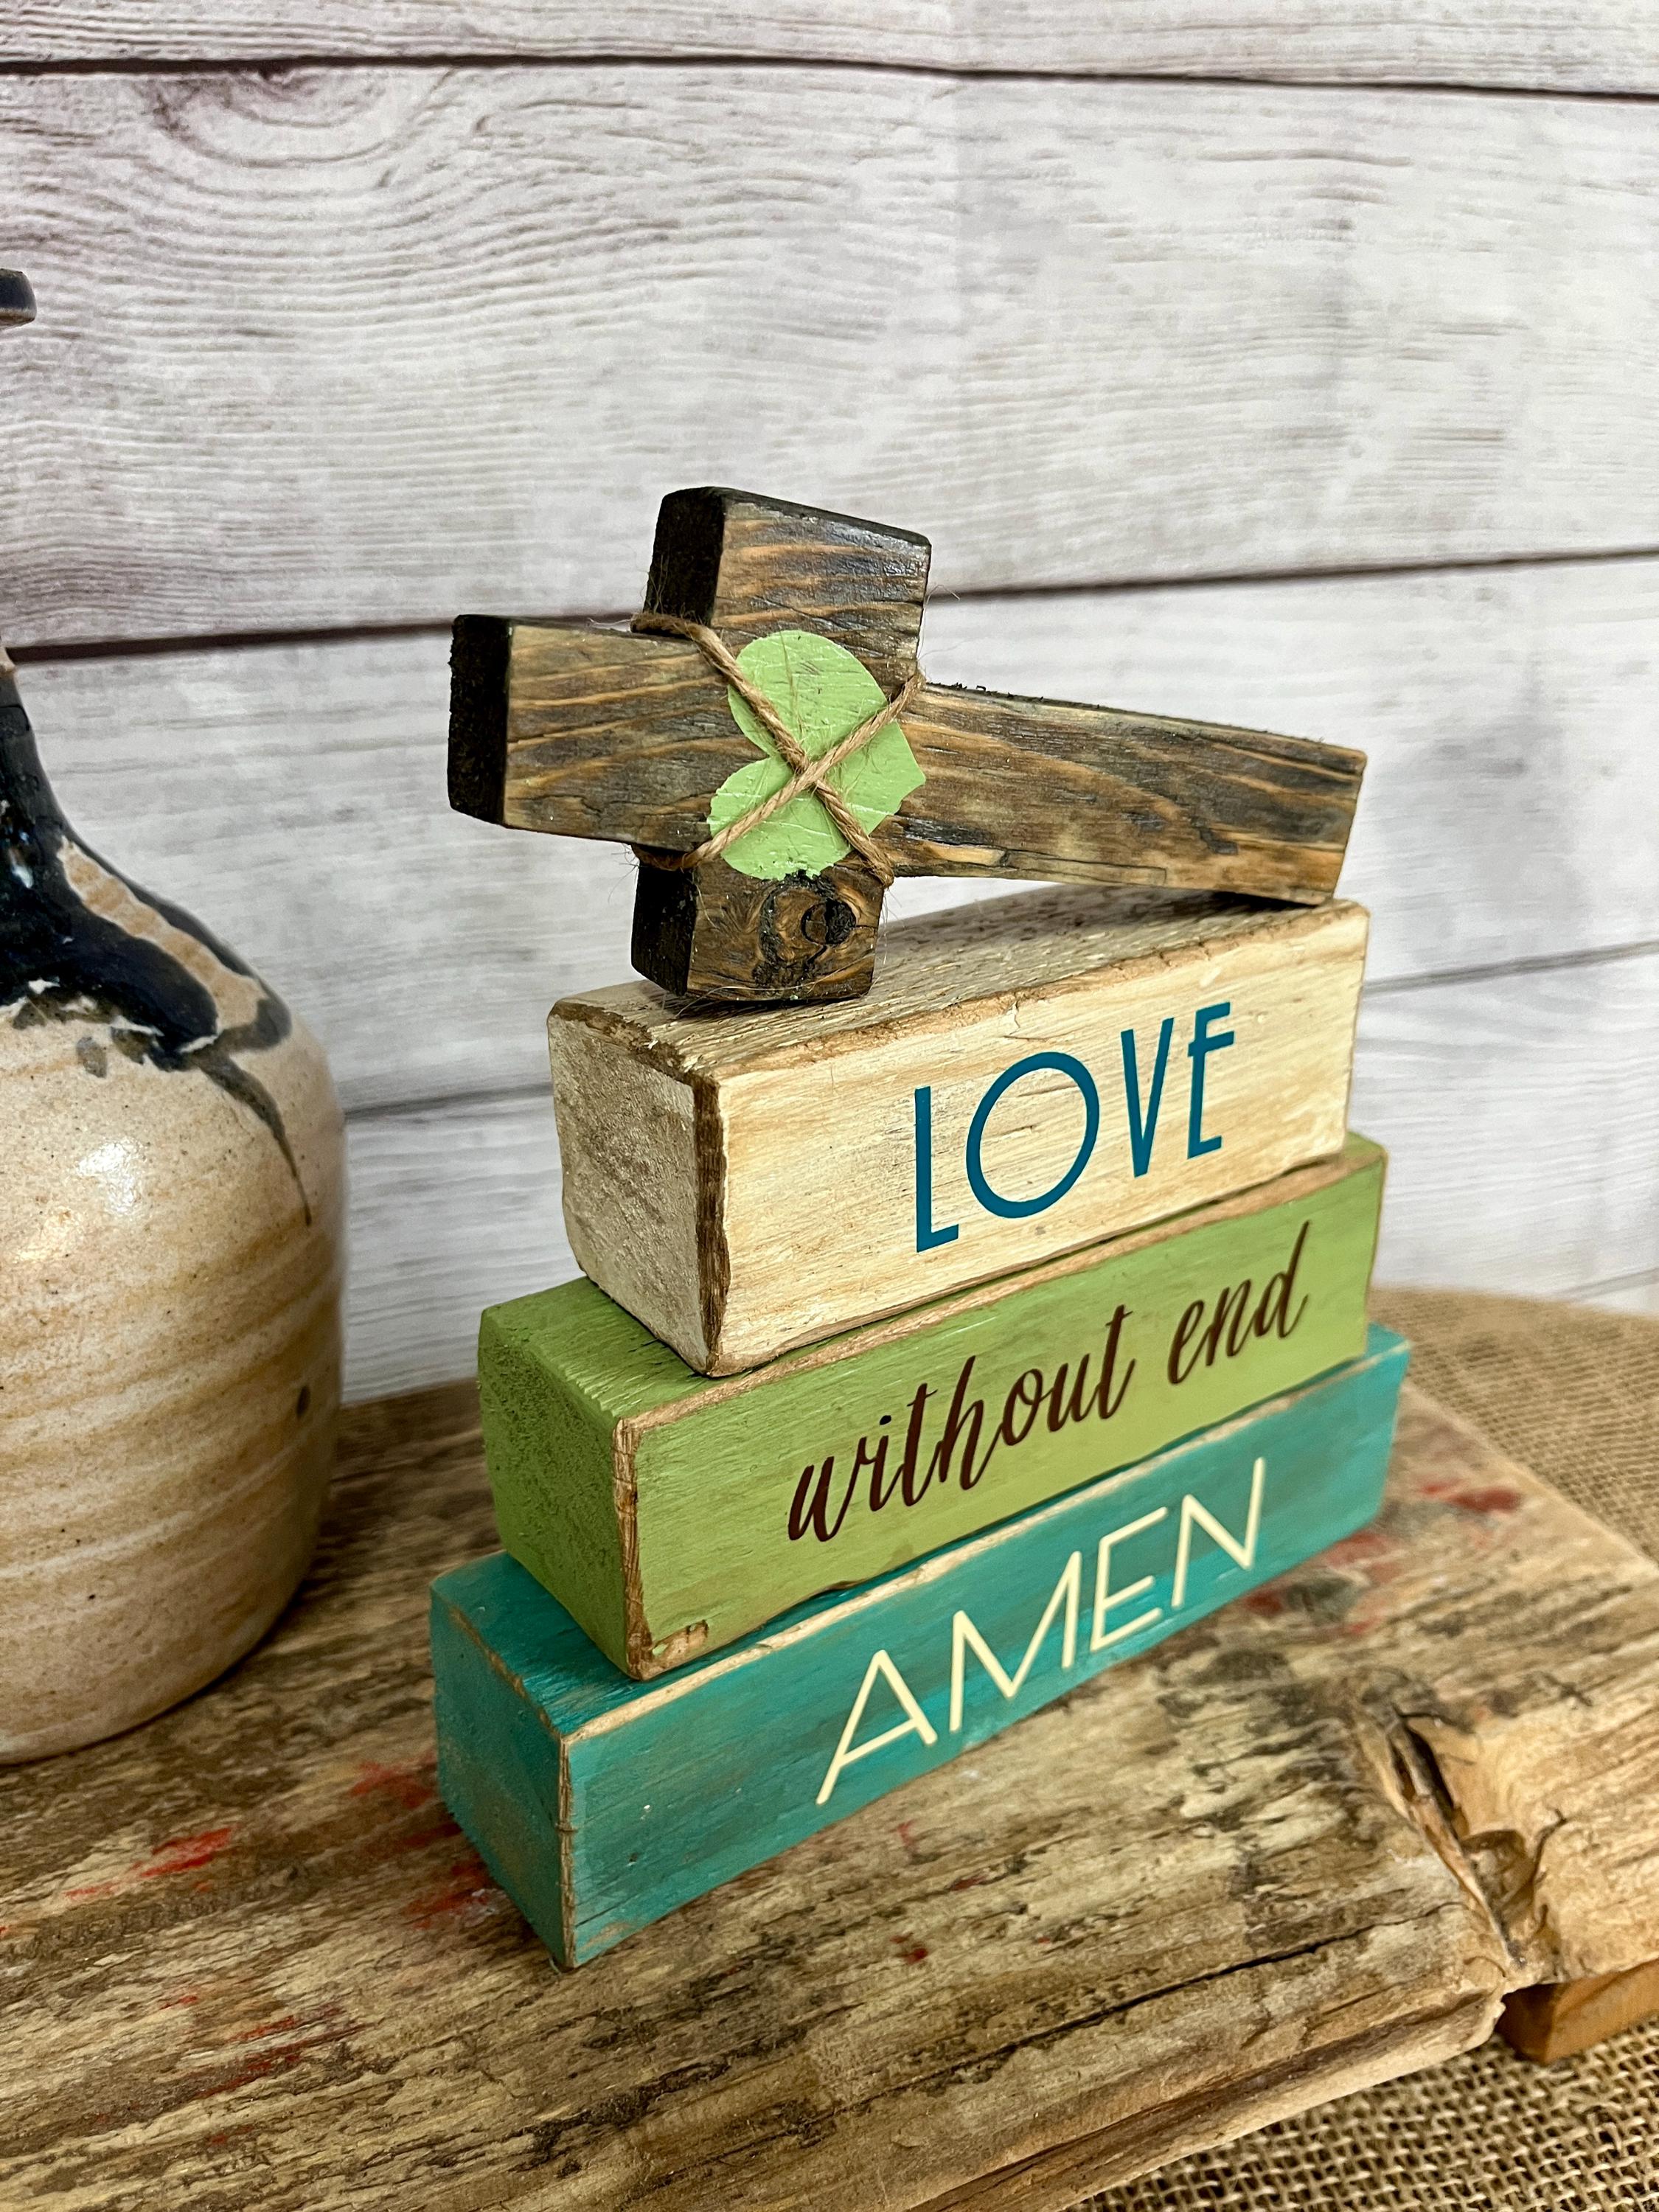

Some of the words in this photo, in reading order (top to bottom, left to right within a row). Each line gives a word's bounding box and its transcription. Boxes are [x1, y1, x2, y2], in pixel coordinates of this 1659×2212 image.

[914, 1002, 1235, 1253] LOVE
[787, 1304, 1135, 1543] without
[1167, 1220, 1311, 1385] end
[816, 1457, 1265, 1805] AMEN
